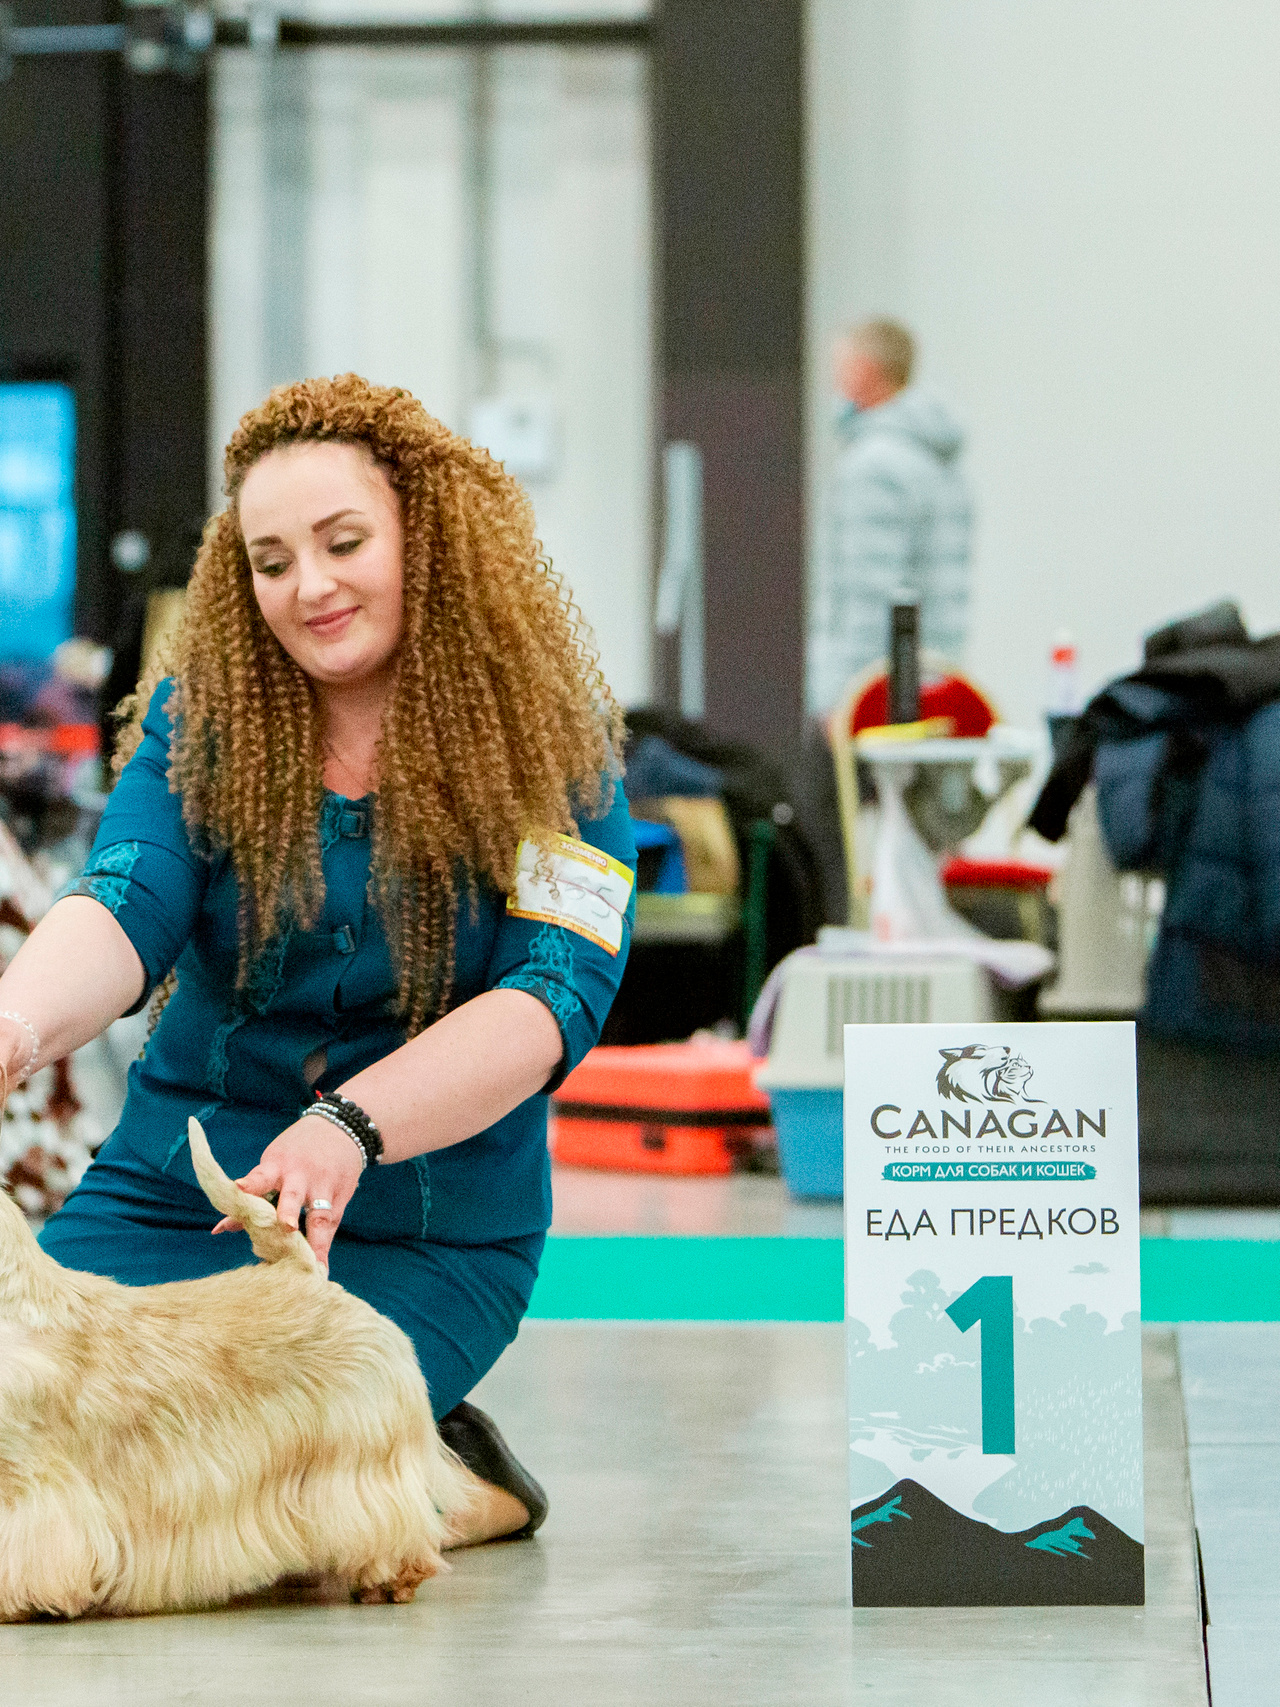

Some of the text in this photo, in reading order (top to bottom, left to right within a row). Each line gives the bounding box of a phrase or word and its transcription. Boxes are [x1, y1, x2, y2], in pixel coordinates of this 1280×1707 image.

[870, 1104, 1107, 1139] CANAGAN
[885, 1146, 909, 1154] THE
[915, 1146, 950, 1154] FOOD
[978, 1145, 1016, 1153] THEIR
[1021, 1145, 1096, 1153] ANCESTORS
[892, 1164, 1087, 1179] КОРМ ДЛЯ СОБАК И КОШЕК
[867, 1208, 1120, 1241] ЕДА ПРЕДКОВ
[945, 1276, 1016, 1454] 1
